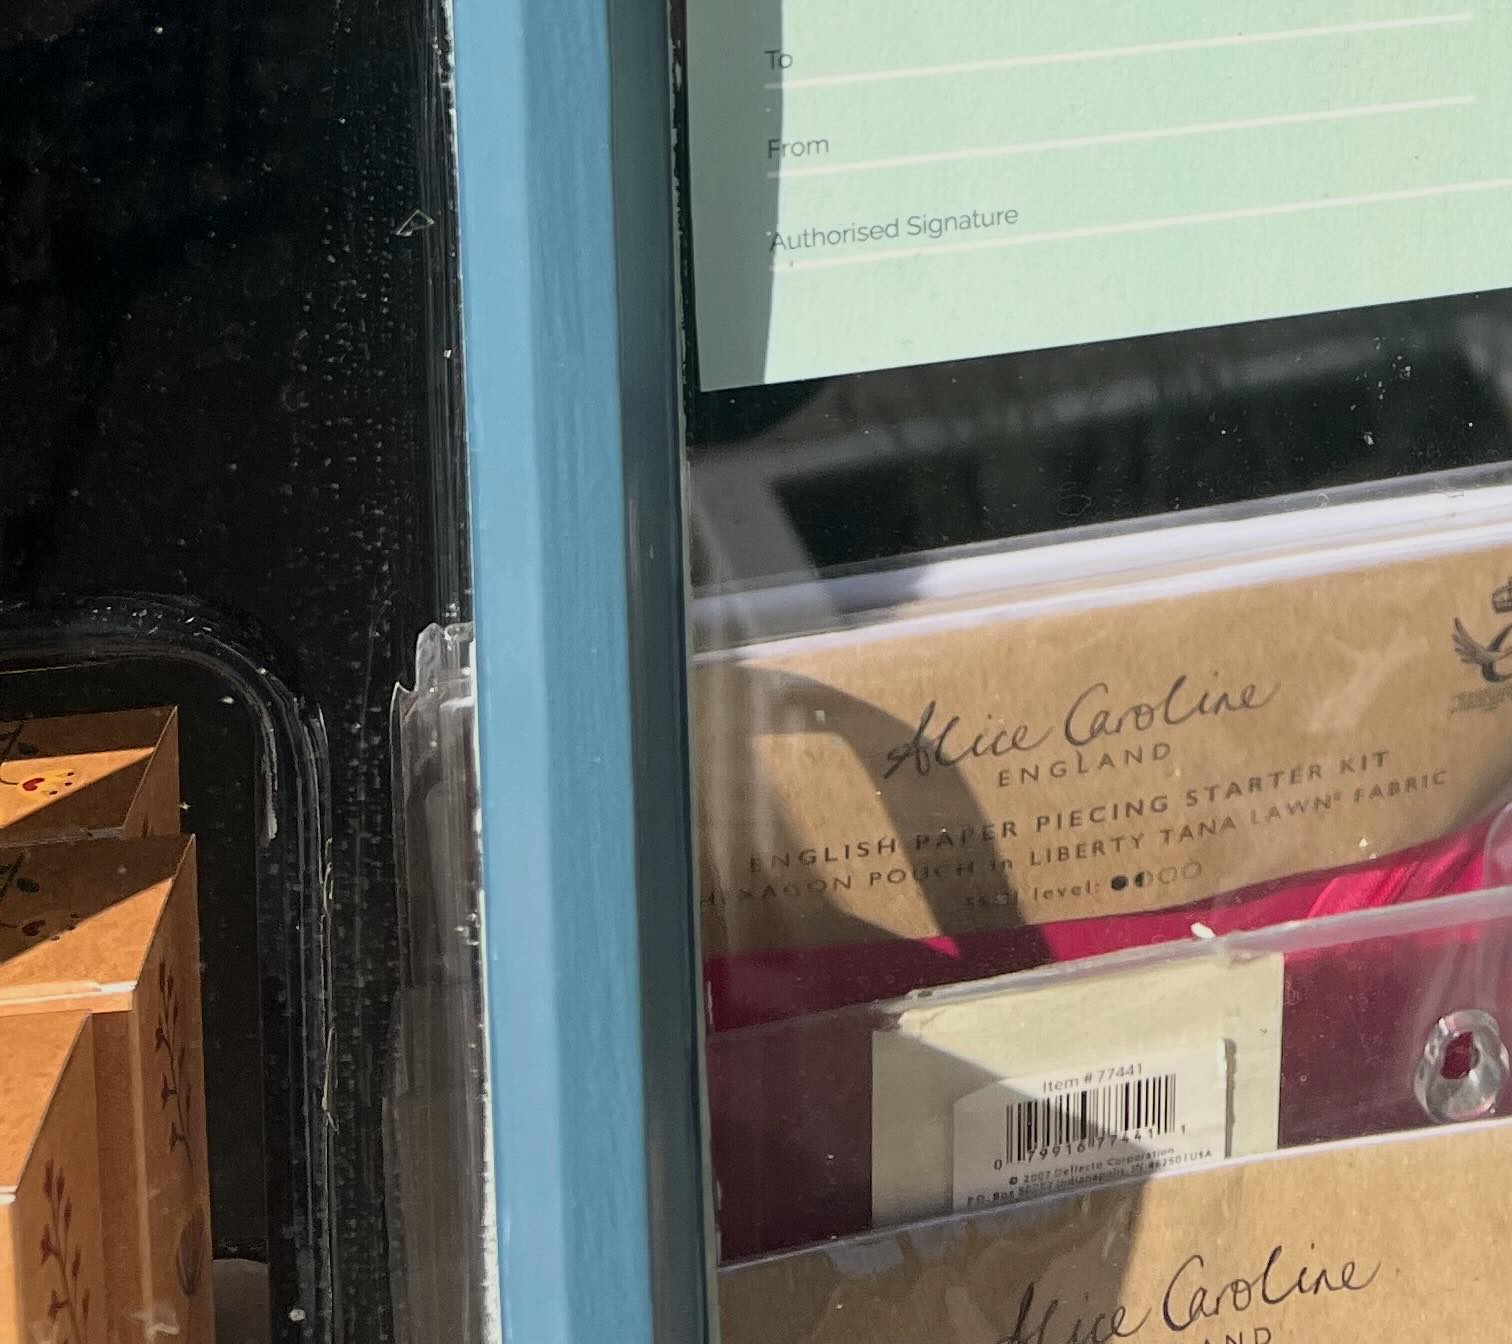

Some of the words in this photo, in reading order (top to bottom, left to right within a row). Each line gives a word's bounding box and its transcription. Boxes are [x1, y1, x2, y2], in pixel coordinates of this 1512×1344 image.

[764, 49, 793, 70] To
[767, 138, 829, 159] From
[769, 218, 900, 252] Authorised
[906, 208, 1019, 238] Signature
[883, 700, 1055, 778] Alice
[1064, 671, 1282, 746] Caroline
[998, 741, 1172, 787] ENGLAND
[749, 838, 897, 873] ENGLISH
[915, 820, 1018, 852] PAPER
[1035, 795, 1169, 833] PIECING
[1186, 762, 1323, 808] STARTER
[1339, 749, 1390, 775] KIT
[869, 859, 975, 888] POUCH
[989, 858, 1014, 874] in
[1028, 833, 1145, 868] LIBERTY
[1160, 815, 1237, 845] TANA
[1353, 769, 1449, 805] FABRIC
[1043, 1078, 1080, 1094] Item
[1098, 1063, 1143, 1081] 77441
[1162, 1242, 1382, 1333] Caroline
